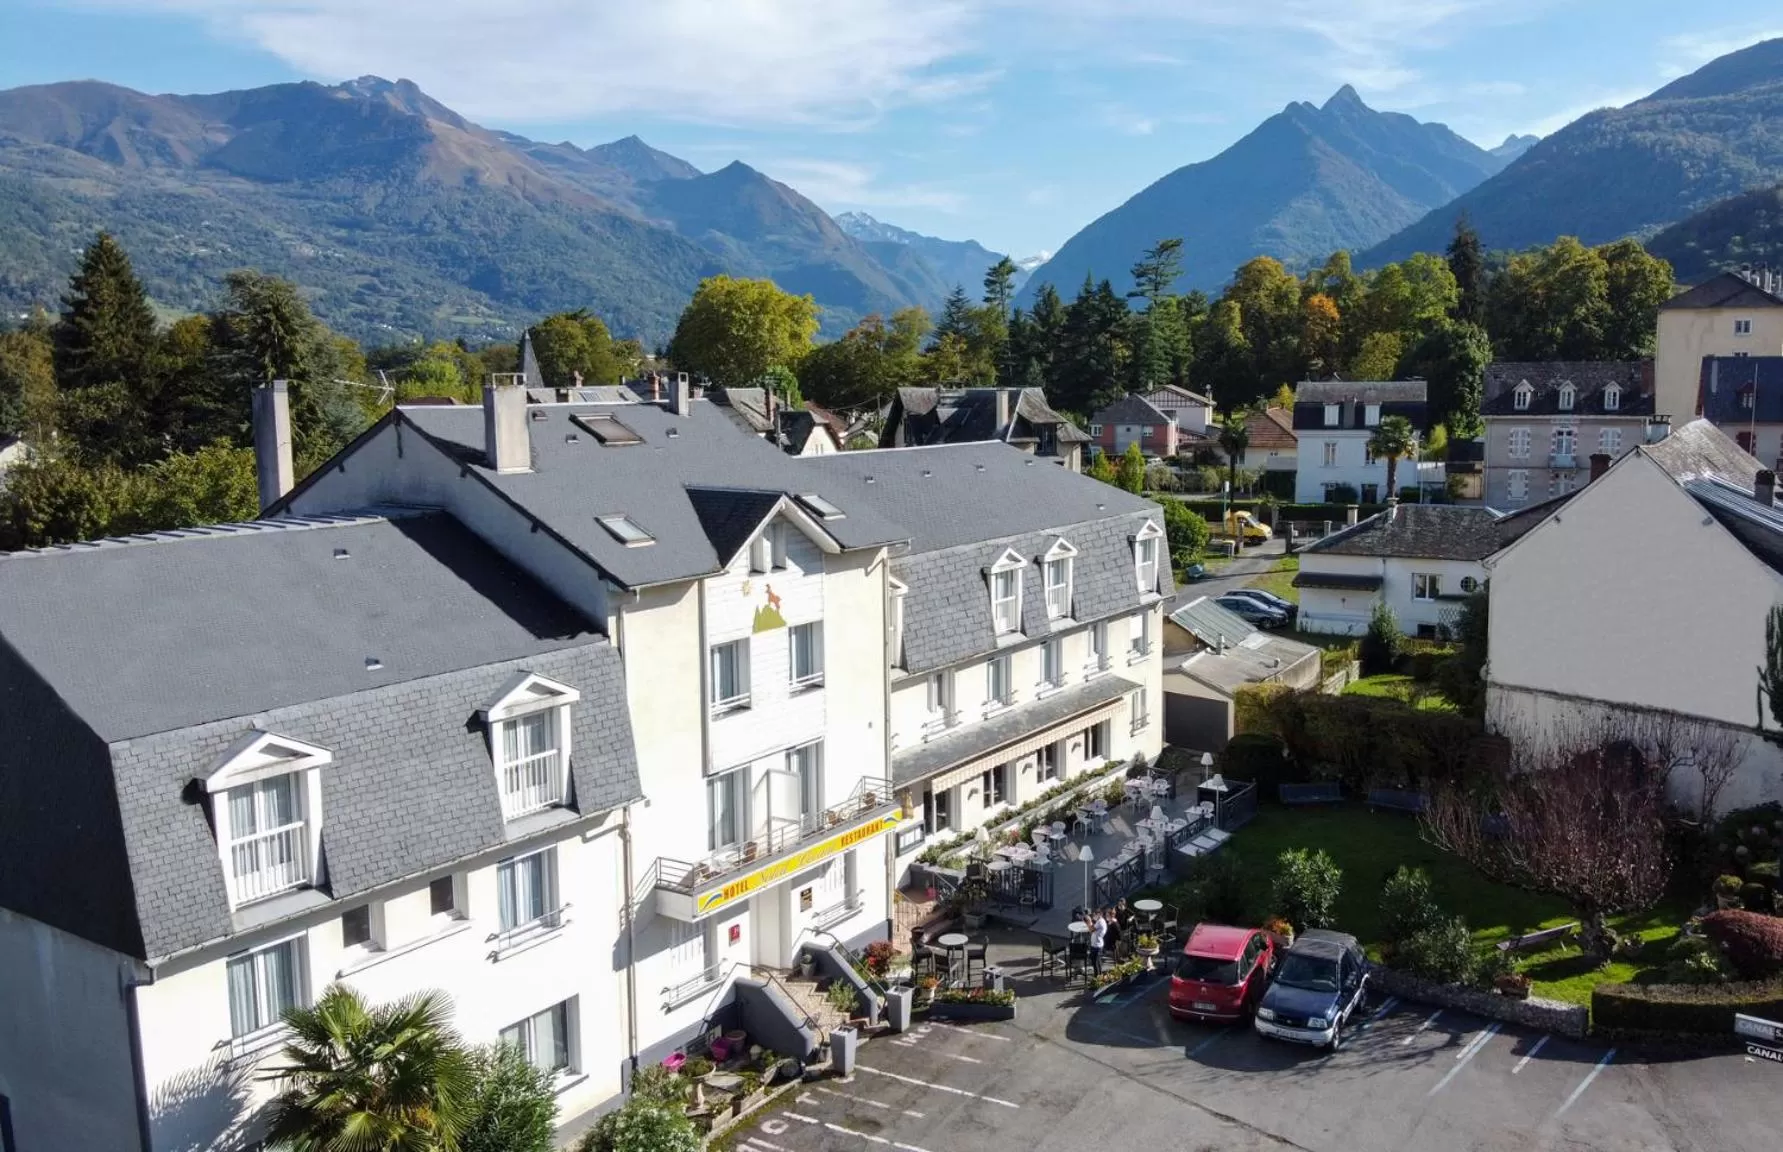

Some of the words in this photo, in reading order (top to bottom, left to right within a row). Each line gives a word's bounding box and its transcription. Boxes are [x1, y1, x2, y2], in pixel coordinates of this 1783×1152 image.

[723, 879, 748, 900] HOTEL
[841, 818, 883, 848] RESTAURANT
[1738, 1020, 1783, 1038] CANALS
